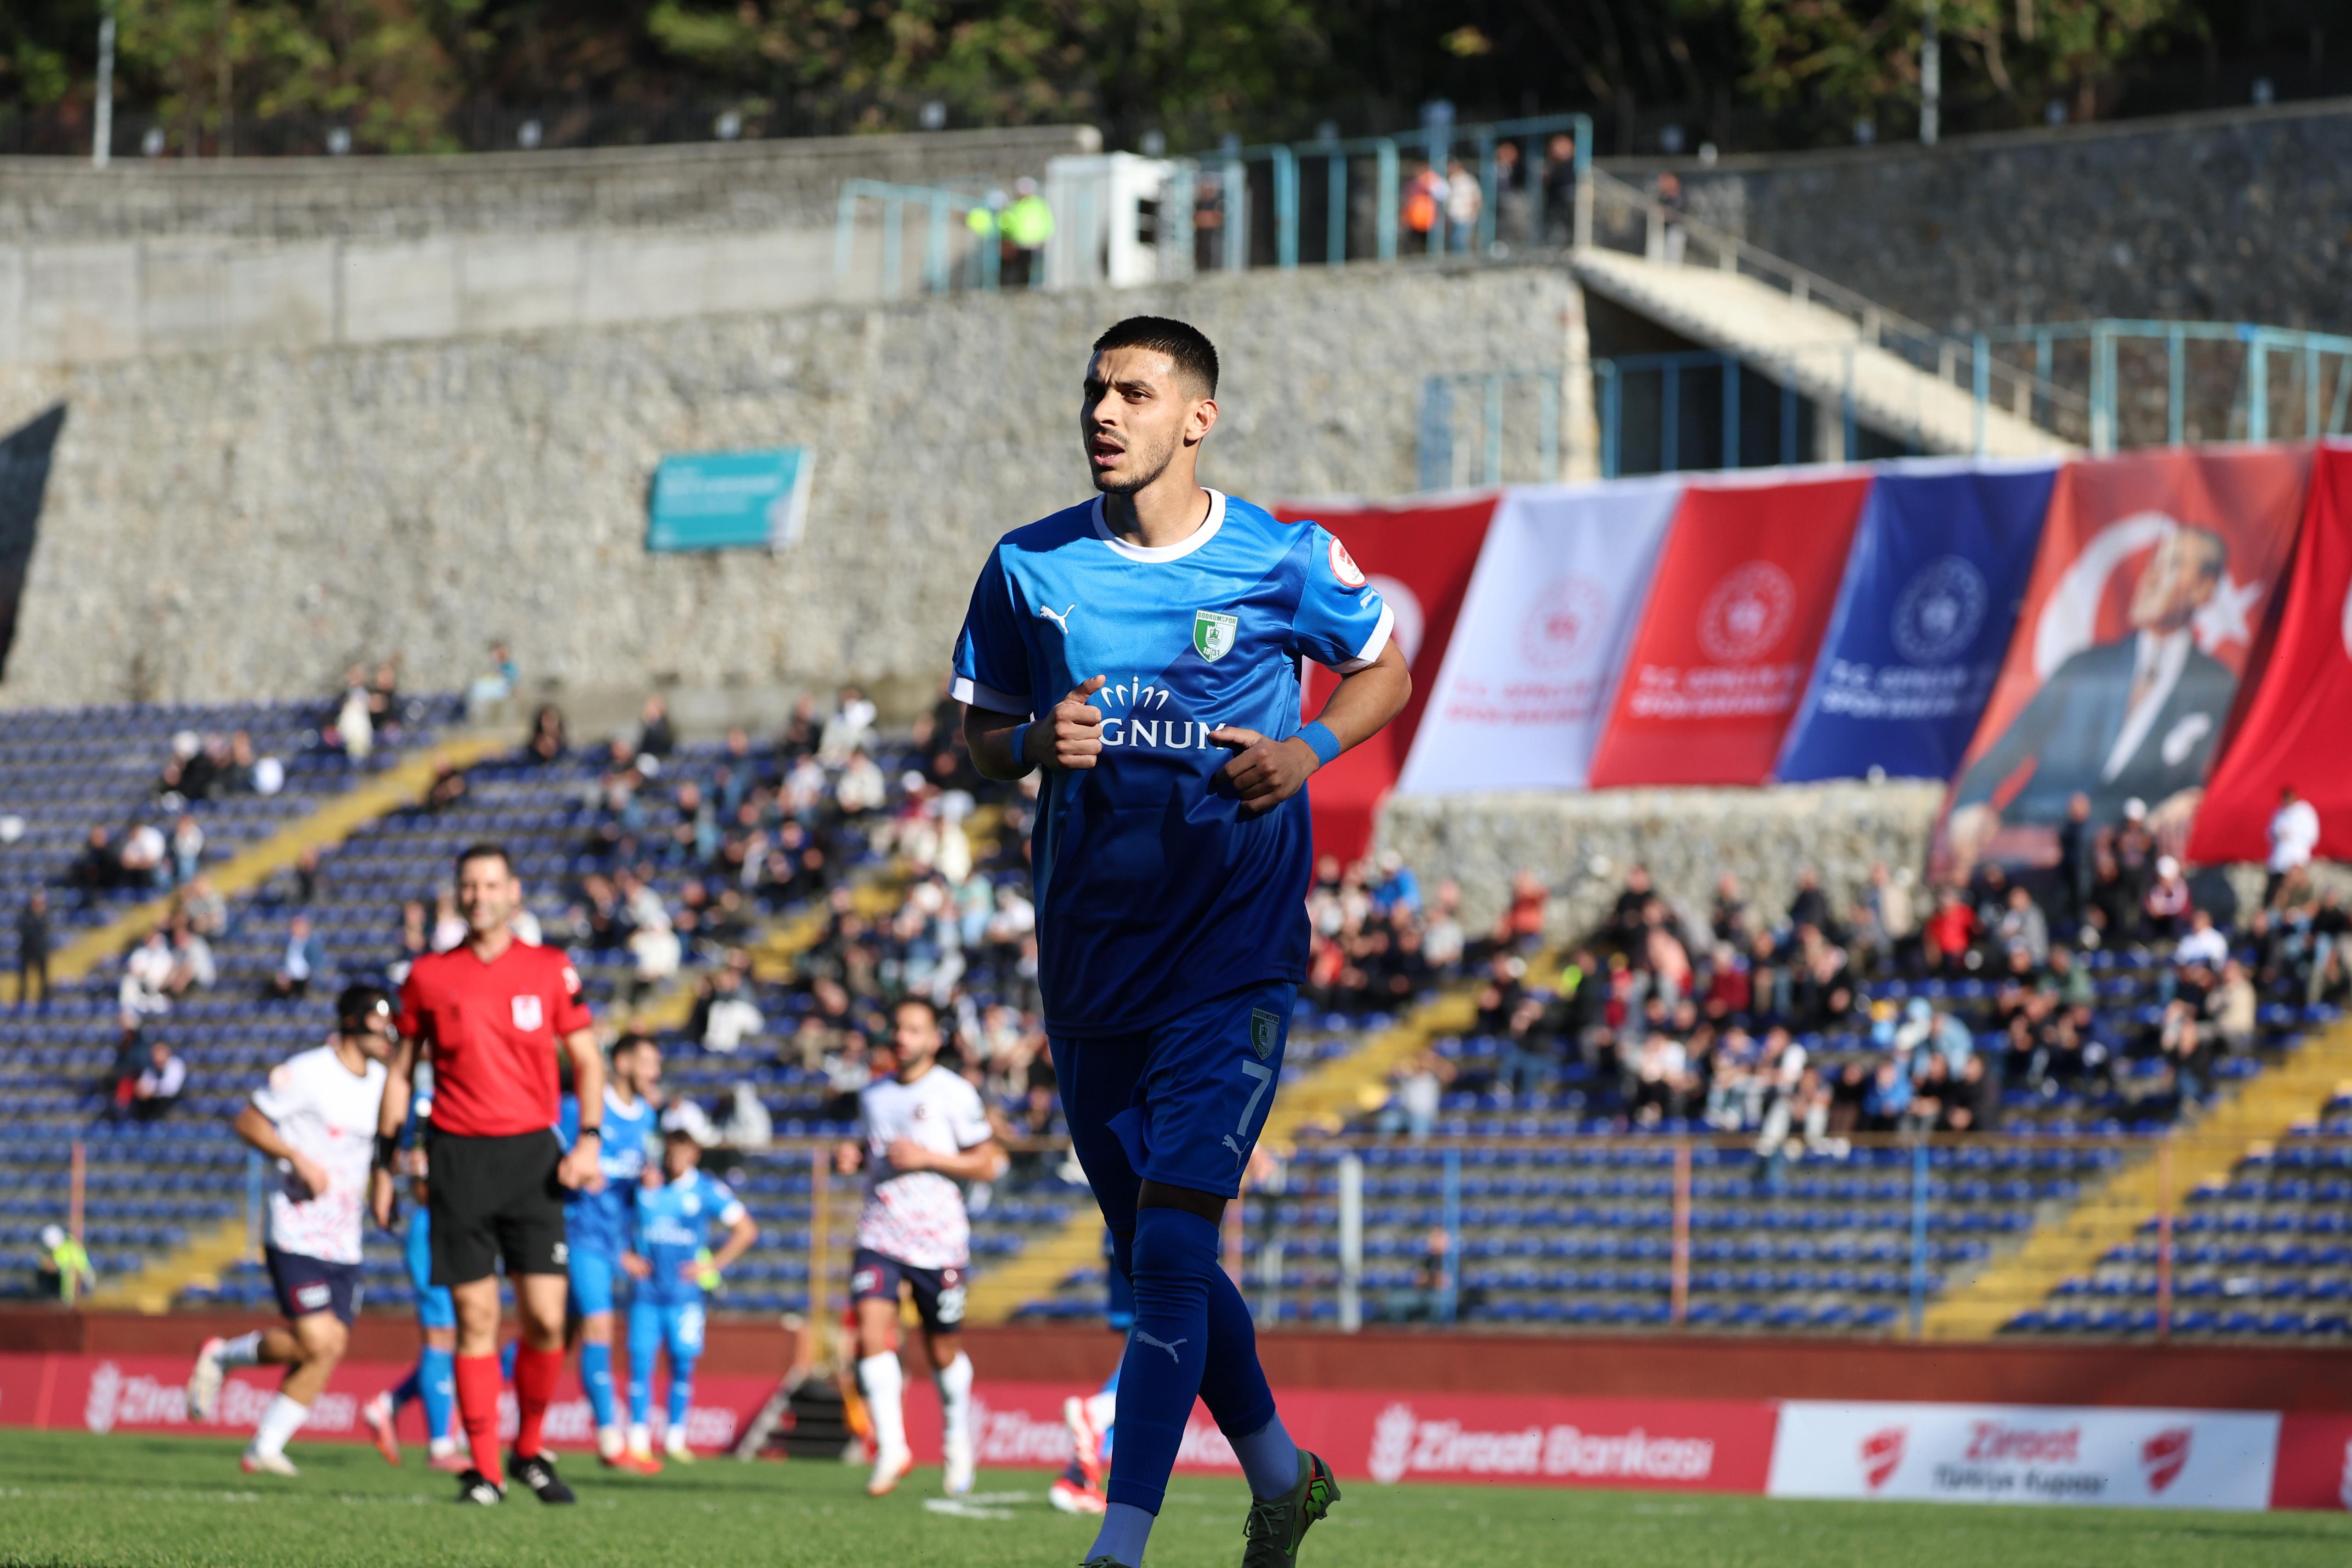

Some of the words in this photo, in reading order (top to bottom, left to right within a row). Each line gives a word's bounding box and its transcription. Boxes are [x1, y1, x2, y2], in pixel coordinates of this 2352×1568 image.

[1198, 612, 1236, 624] BODRUMSPOR
[1098, 718, 1226, 750] GNUM
[1253, 1010, 1279, 1023] BODRUMSPOR
[1237, 1060, 1273, 1137] 7
[1413, 1419, 1543, 1473] Ziraat
[1965, 1420, 2082, 1462] Ziraat
